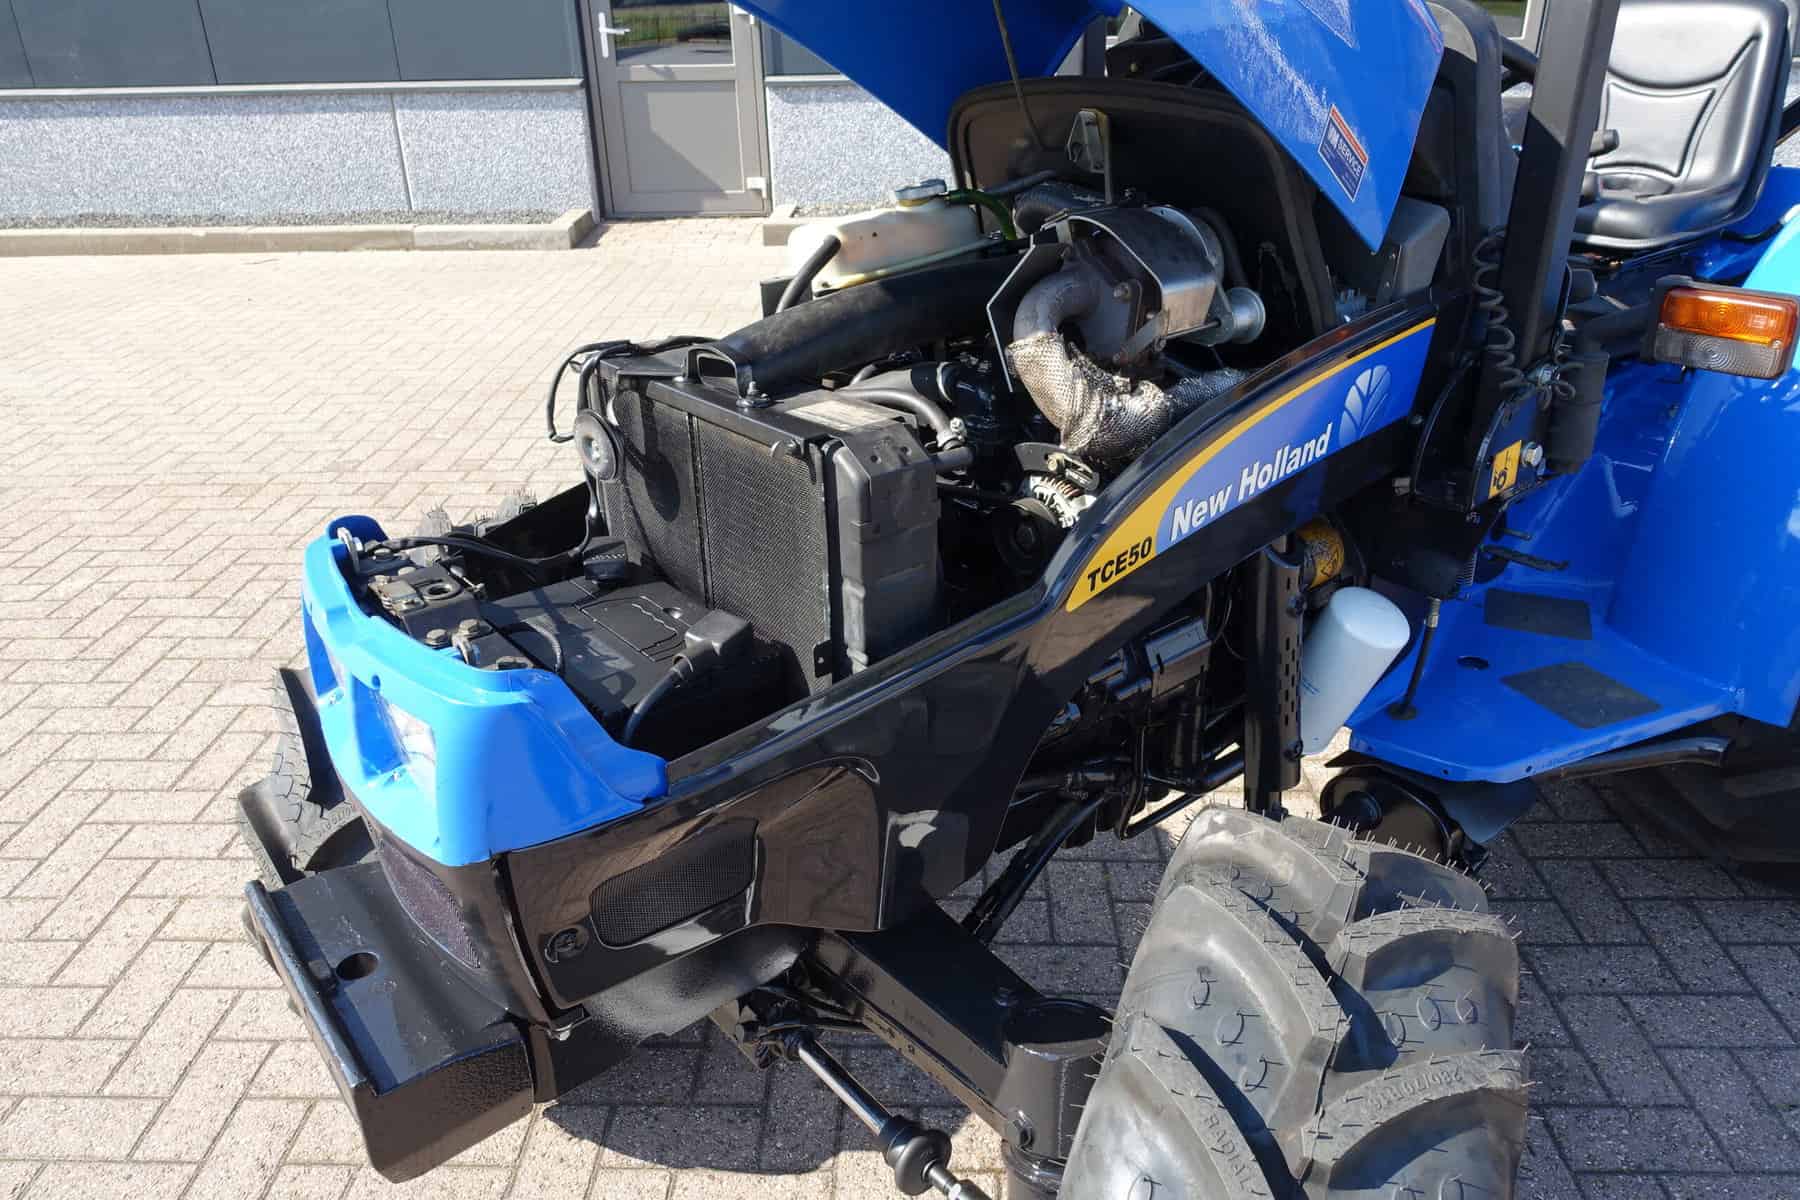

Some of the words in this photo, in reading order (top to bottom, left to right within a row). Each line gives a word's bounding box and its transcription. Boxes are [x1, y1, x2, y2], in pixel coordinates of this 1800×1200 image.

[1169, 484, 1232, 542] New
[1236, 423, 1333, 501] Holland
[1087, 536, 1152, 592] TCE50
[1202, 1112, 1250, 1191] RADIAL
